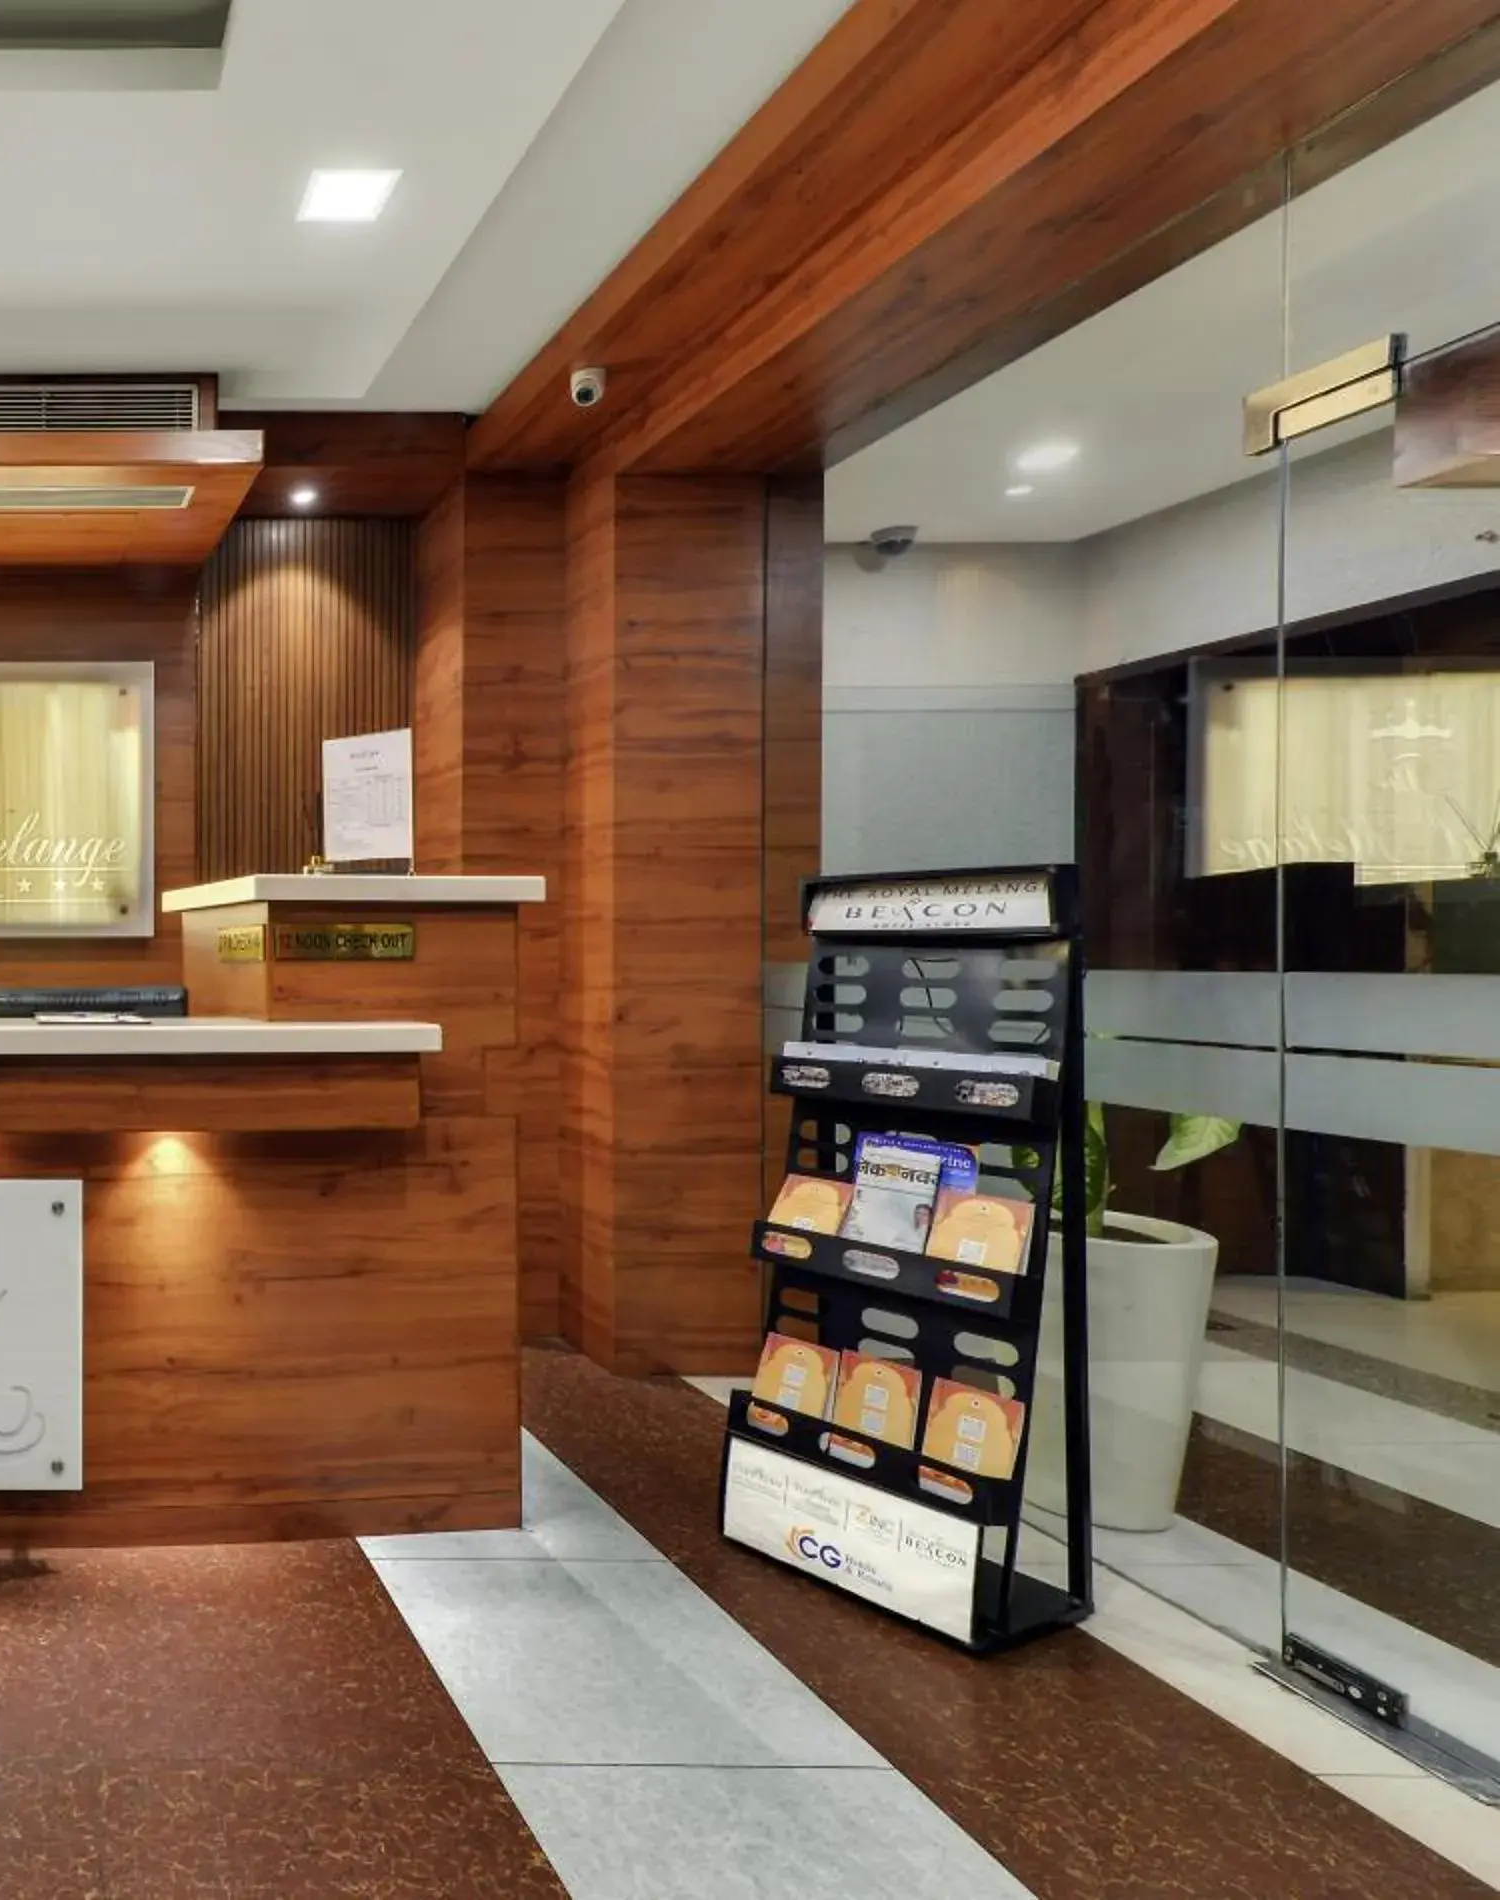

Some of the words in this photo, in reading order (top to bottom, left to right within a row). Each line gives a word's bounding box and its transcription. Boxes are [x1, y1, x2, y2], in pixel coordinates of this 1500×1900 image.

[943, 879, 1048, 899] MELANG
[380, 932, 408, 949] OUT
[798, 1535, 842, 1569] CG
